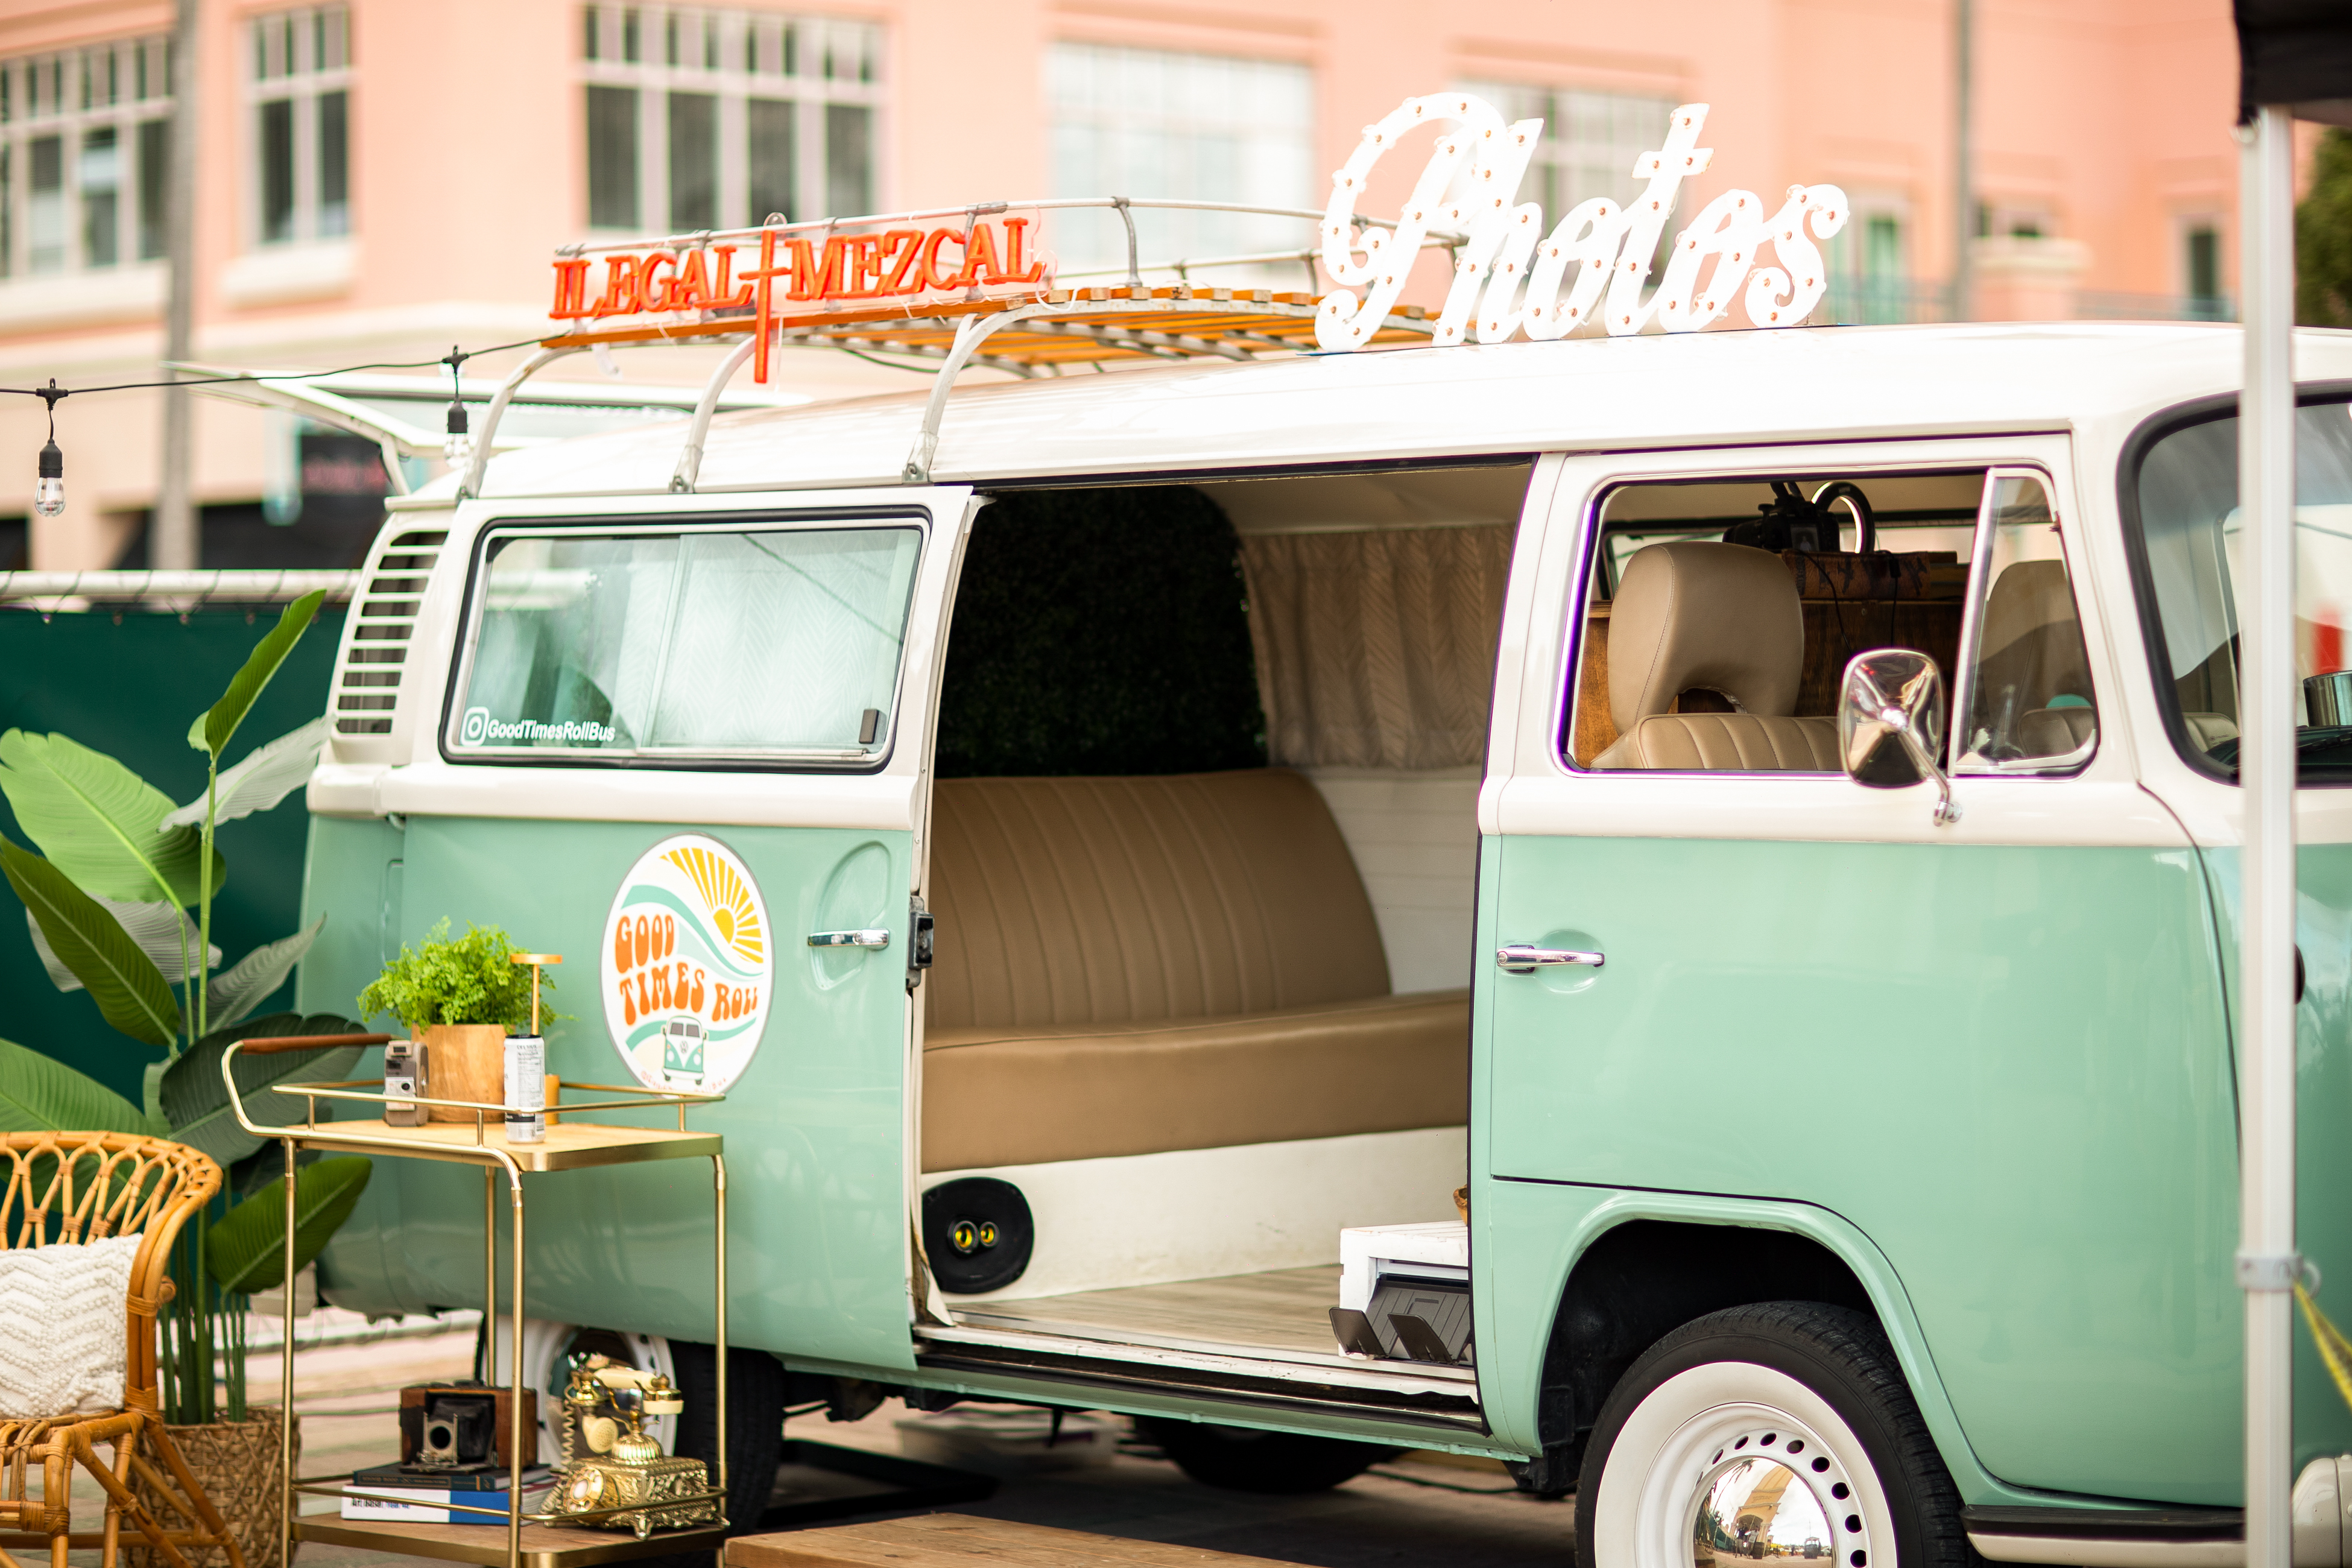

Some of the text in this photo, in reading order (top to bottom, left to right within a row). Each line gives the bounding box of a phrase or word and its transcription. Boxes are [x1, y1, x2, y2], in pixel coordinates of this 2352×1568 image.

[1314, 92, 1850, 353] Photos
[549, 217, 1048, 320] ILEGAL MEZCAL
[487, 718, 616, 742] GoodTimesRollBus
[615, 914, 675, 974] GOOD
[619, 962, 757, 1026] TIMES ROLL
